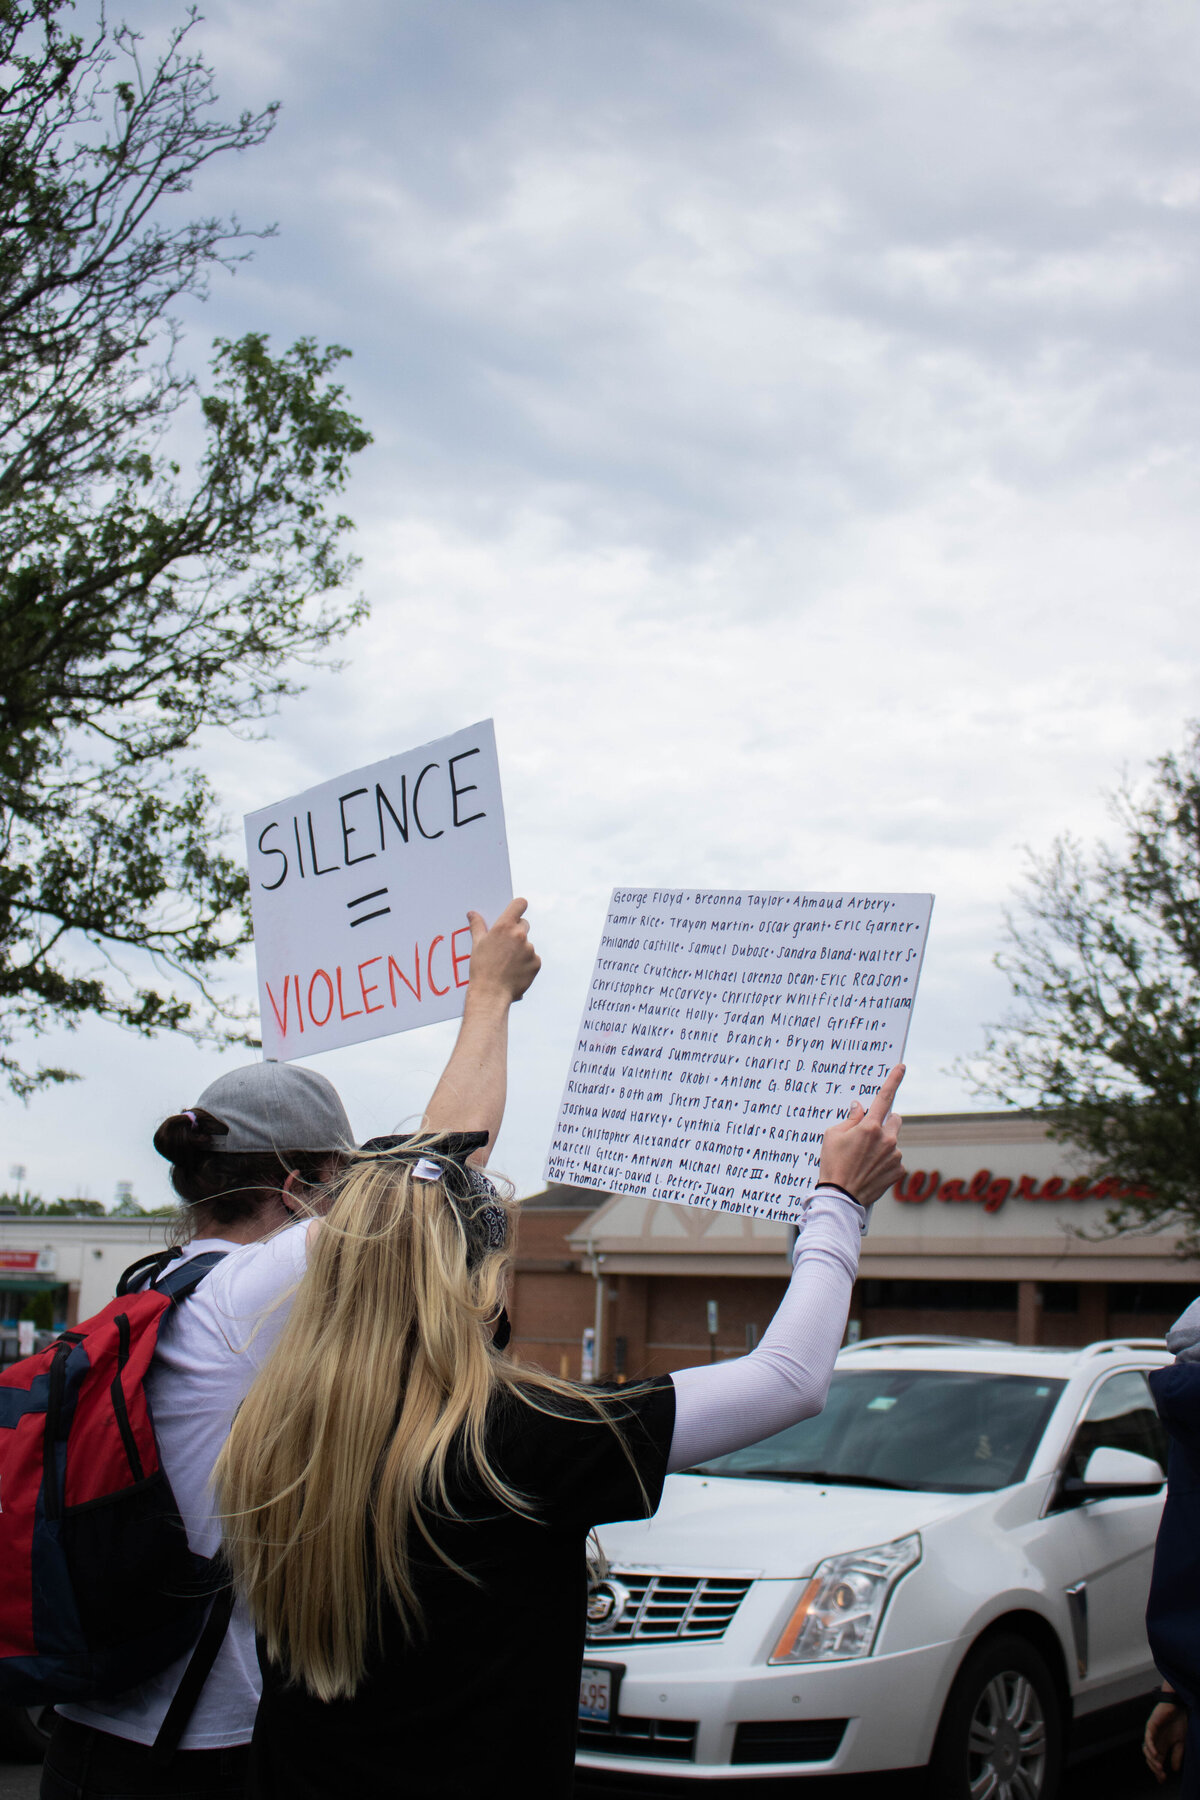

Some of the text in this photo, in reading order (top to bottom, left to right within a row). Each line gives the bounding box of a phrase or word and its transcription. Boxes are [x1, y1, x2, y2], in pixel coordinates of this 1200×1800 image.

[259, 748, 486, 890] SILENCE
[614, 892, 890, 912] George Floyd Breonna Taylor Ahmaud Arbery
[608, 914, 637, 925] Tamir
[640, 916, 660, 927] Rice
[711, 921, 749, 931] Martin
[834, 920, 861, 931] Eric
[866, 920, 914, 934] Garner
[602, 936, 640, 949] Philando
[688, 942, 726, 955] Samuel
[732, 944, 769, 958] Dubose
[776, 946, 816, 960] Sandra
[820, 947, 852, 960] Bland
[859, 950, 903, 962] Walter
[266, 926, 472, 1038] VIOLENCE
[598, 958, 901, 987] Terrance Crutcher Michael Lorenzo Dean Eric Reason
[592, 979, 654, 996] Christopher
[786, 992, 853, 1007] Whitfield
[589, 997, 630, 1012] Jefferson
[638, 1003, 680, 1018] Maurice
[686, 1008, 714, 1024] Holly
[724, 1011, 764, 1025] Jordan
[771, 1013, 820, 1028] Michael
[584, 1020, 627, 1033] Nicholas
[631, 1024, 669, 1036] Walker
[680, 1028, 718, 1043] Bennie
[727, 1030, 772, 1048] Branch
[831, 1039, 888, 1052] Williams
[573, 1060, 616, 1076] Chinedu
[622, 1066, 672, 1081] Valentine
[784, 1078, 818, 1093] Black
[621, 1045, 663, 1058] Edward
[811, 1060, 874, 1076] Roundtree
[568, 1080, 610, 1095] Richards
[669, 1092, 700, 1107] Shern
[703, 1096, 732, 1110] Jean
[742, 1100, 782, 1115] James
[786, 1105, 834, 1119] Leather
[562, 1103, 598, 1117] Joshua
[602, 1108, 627, 1121] Wood
[630, 1111, 667, 1128] Harvey
[677, 1116, 720, 1132] Cynthia
[726, 1121, 760, 1136] Fields
[552, 1140, 590, 1155] Marcell
[596, 1147, 624, 1162] Green
[631, 1154, 672, 1169] Antwon
[679, 1159, 720, 1174] Michael
[726, 1164, 748, 1178] Rose
[749, 1168, 764, 1180] III
[774, 1172, 812, 1188] Robert
[633, 1134, 691, 1148] Alexander
[752, 1148, 799, 1168] Anthony
[548, 1166, 565, 1181] Ray
[568, 1172, 602, 1187] Thomas
[610, 1180, 646, 1194] Stephon
[688, 1193, 717, 1209] Corey
[549, 1156, 574, 1169] White
[666, 1174, 699, 1191] Peters
[704, 1182, 734, 1198] Juan
[788, 1195, 802, 1207] Jo
